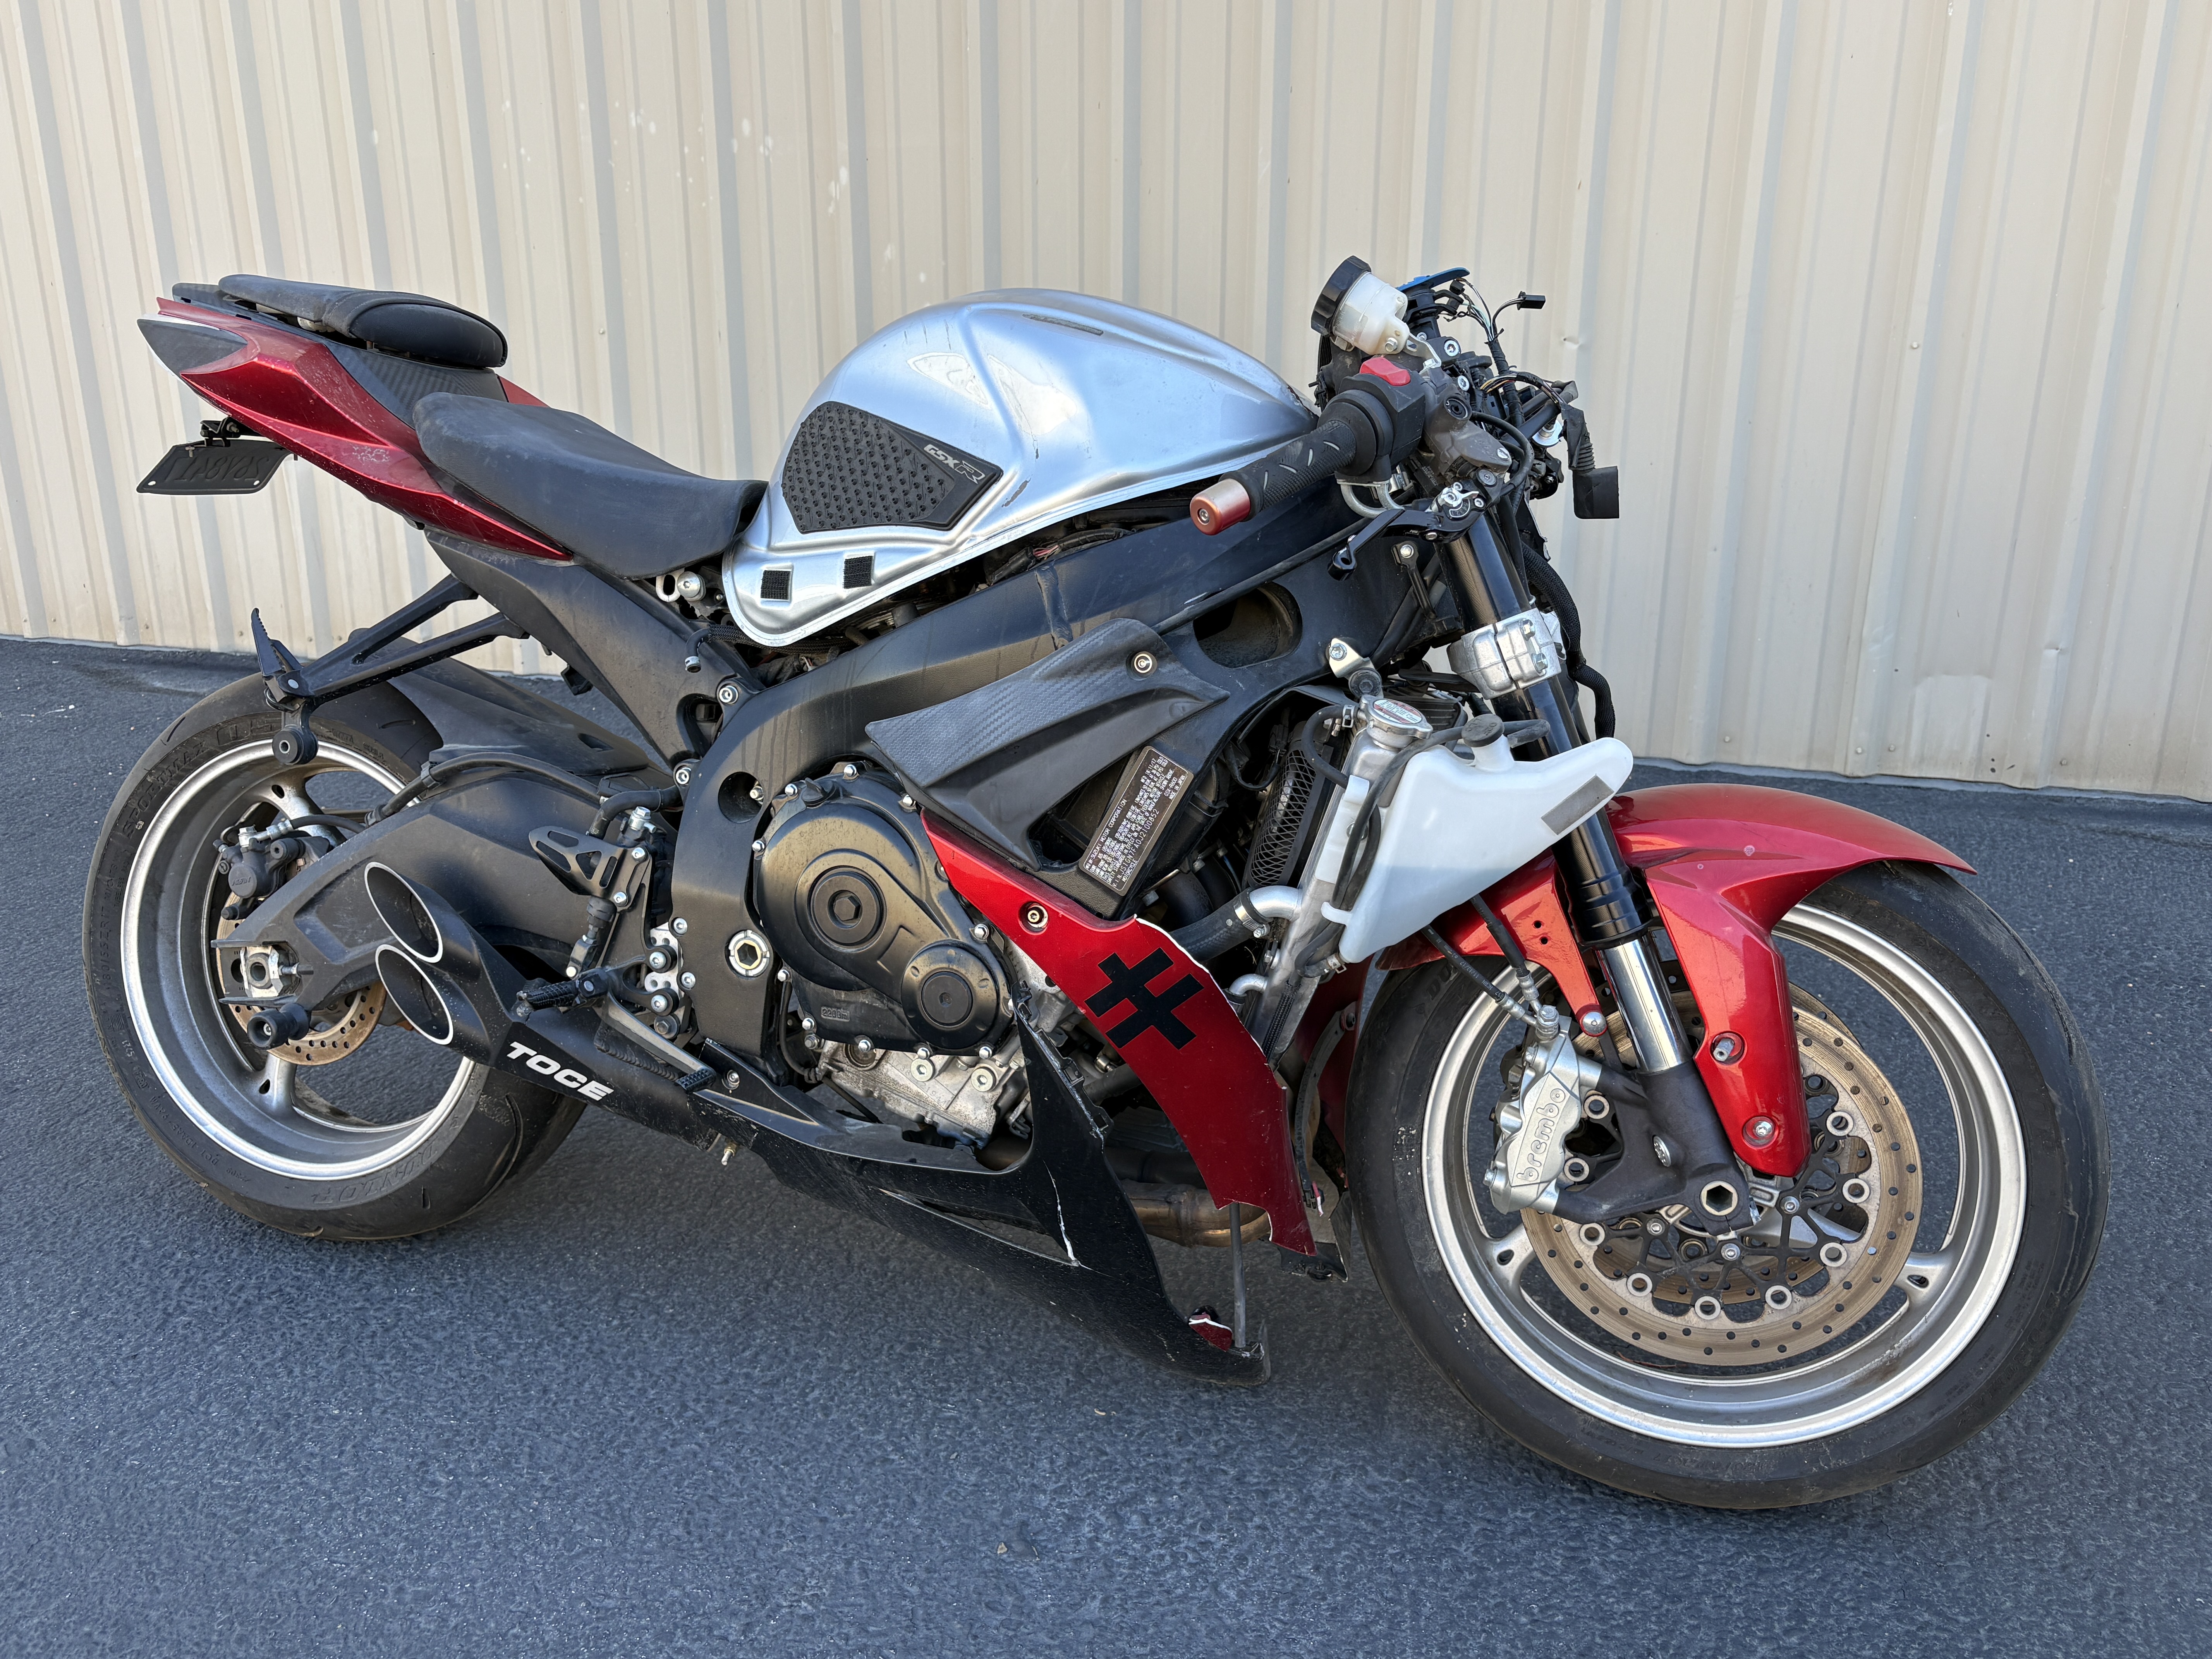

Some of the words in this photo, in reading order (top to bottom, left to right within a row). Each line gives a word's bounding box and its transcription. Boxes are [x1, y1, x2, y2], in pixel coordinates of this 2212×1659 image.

[1160, 758, 1169, 768] COLD
[1163, 776, 1178, 797] GSX-R600
[1168, 790, 1176, 800] MADE
[1176, 774, 1186, 786] JAPAN
[1090, 843, 1102, 859] SUZUKI
[1099, 827, 1111, 843] MOTOR
[1108, 798, 1127, 828] CORPORATION
[1106, 857, 1118, 873] VEHICLE
[1114, 842, 1127, 859] CONFORMS
[1130, 811, 1144, 832] APPLICABLE
[1140, 797, 1152, 813] FEDERAL
[1149, 786, 1158, 799] MOTOR
[1155, 772, 1166, 788] VEHICLE
[1106, 871, 1116, 884] SAFETY
[1113, 853, 1126, 872] STANDARDS
[1125, 836, 1135, 850] EFFECT
[1139, 815, 1147, 826] DATE
[1147, 789, 1163, 812] MANUFACTURE
[1159, 778, 1169, 791] SHOWN
[1118, 807, 1159, 876] JS1GN7FA0J2100852
[1121, 857, 1138, 883] MOTORCYCLE
[506, 1041, 614, 1101] TOCE
[1516, 1087, 1566, 1182] brembo
[312, 1144, 438, 1204] DUNLOP
